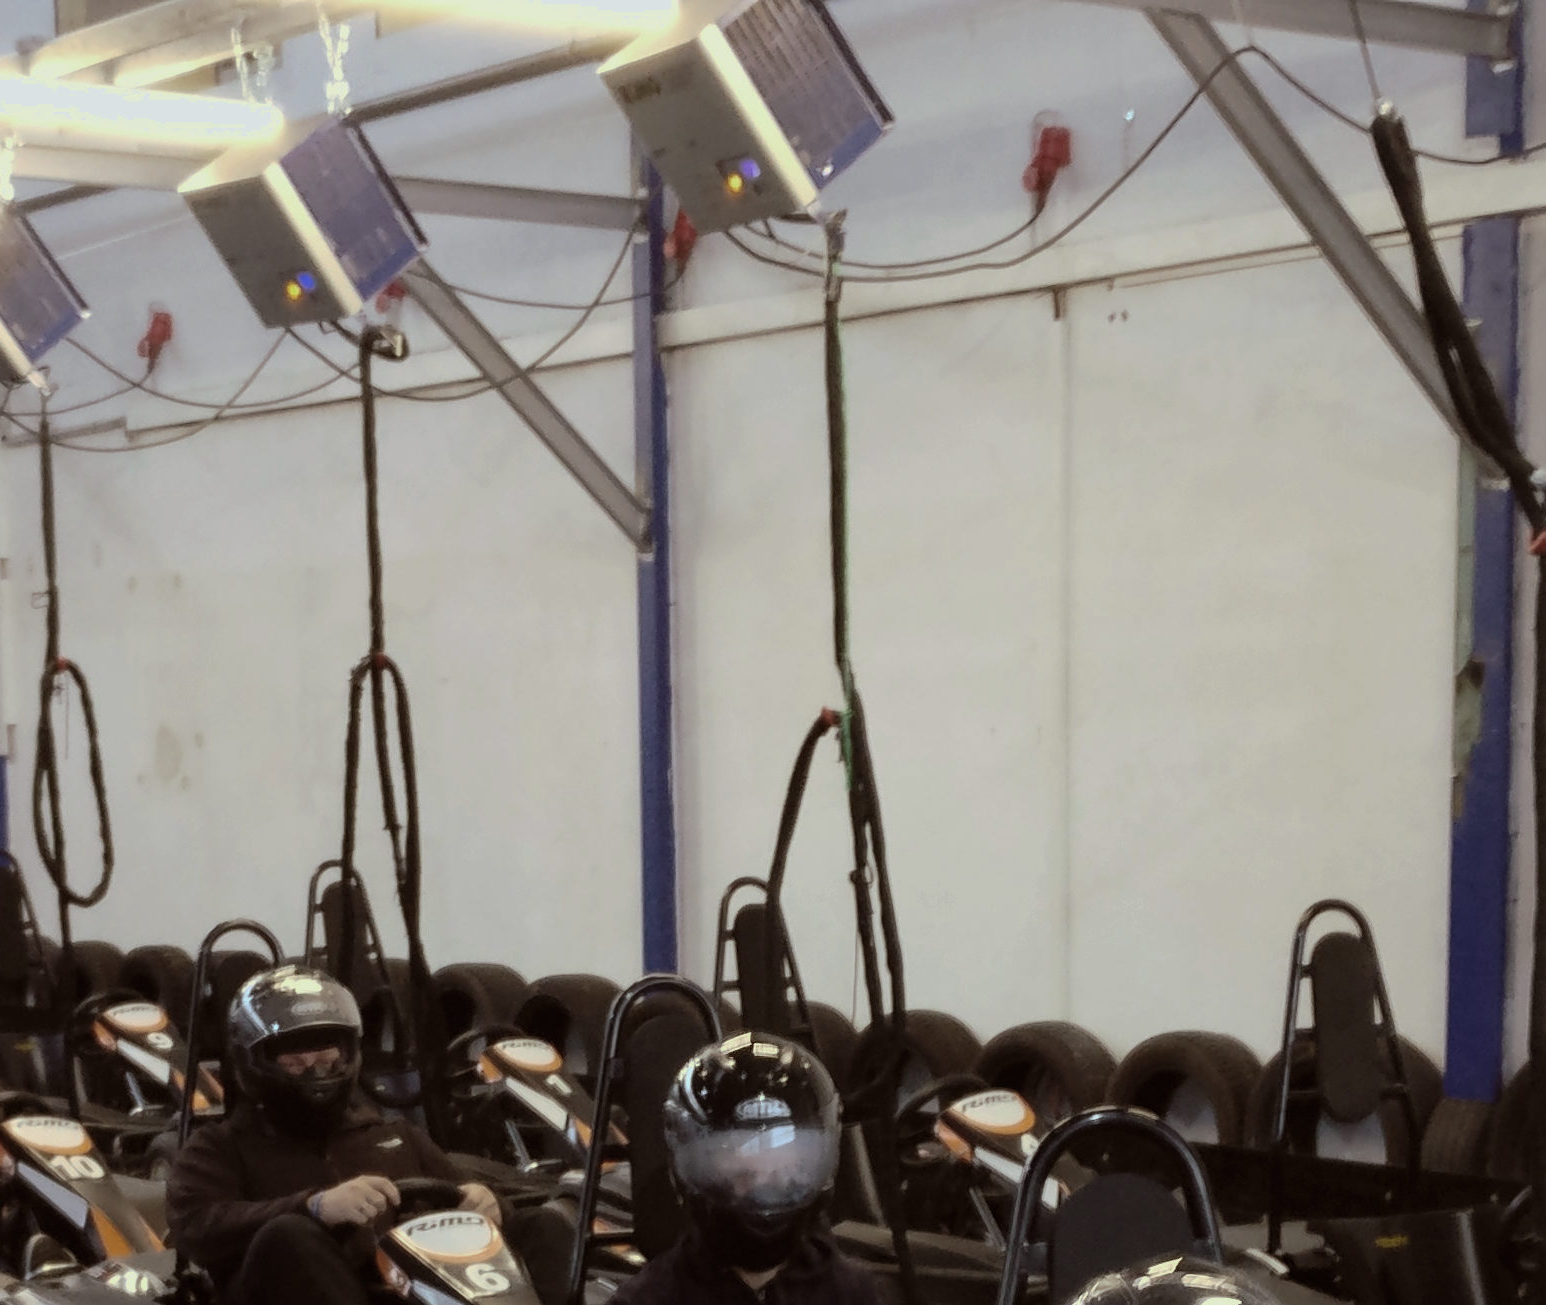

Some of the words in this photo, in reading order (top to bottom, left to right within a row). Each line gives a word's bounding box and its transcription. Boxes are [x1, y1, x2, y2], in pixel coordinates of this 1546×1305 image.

[146, 1032, 173, 1050] 9
[545, 1074, 572, 1096] 1
[51, 1155, 105, 1180] 10
[465, 1262, 510, 1292] 6
